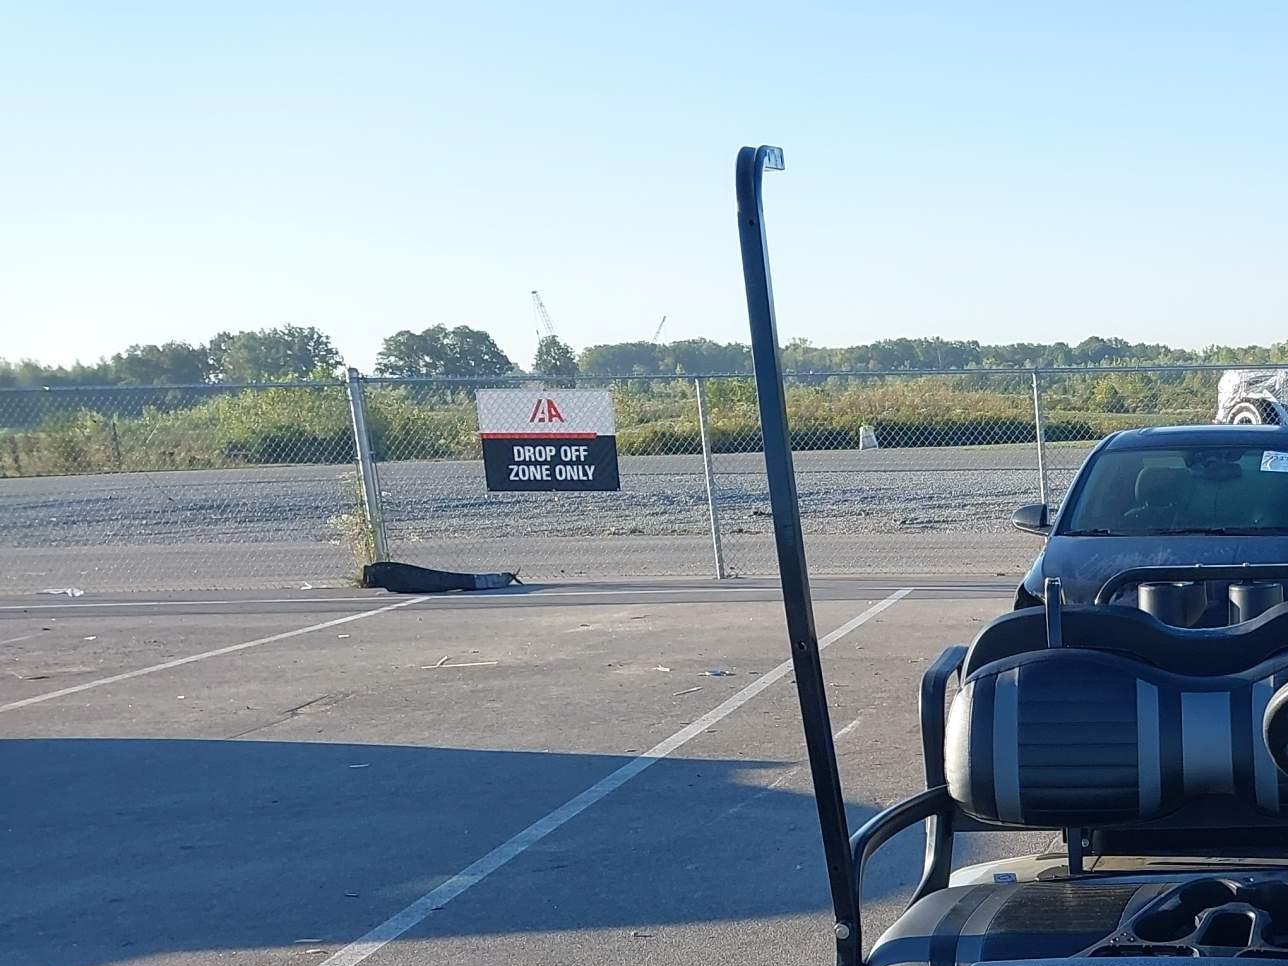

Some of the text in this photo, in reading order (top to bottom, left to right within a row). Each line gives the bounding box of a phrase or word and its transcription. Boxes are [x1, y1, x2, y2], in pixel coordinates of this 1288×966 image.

[529, 398, 565, 423] IAA
[513, 446, 589, 462] DROP OFF
[508, 465, 596, 481] ZONE ONLY
